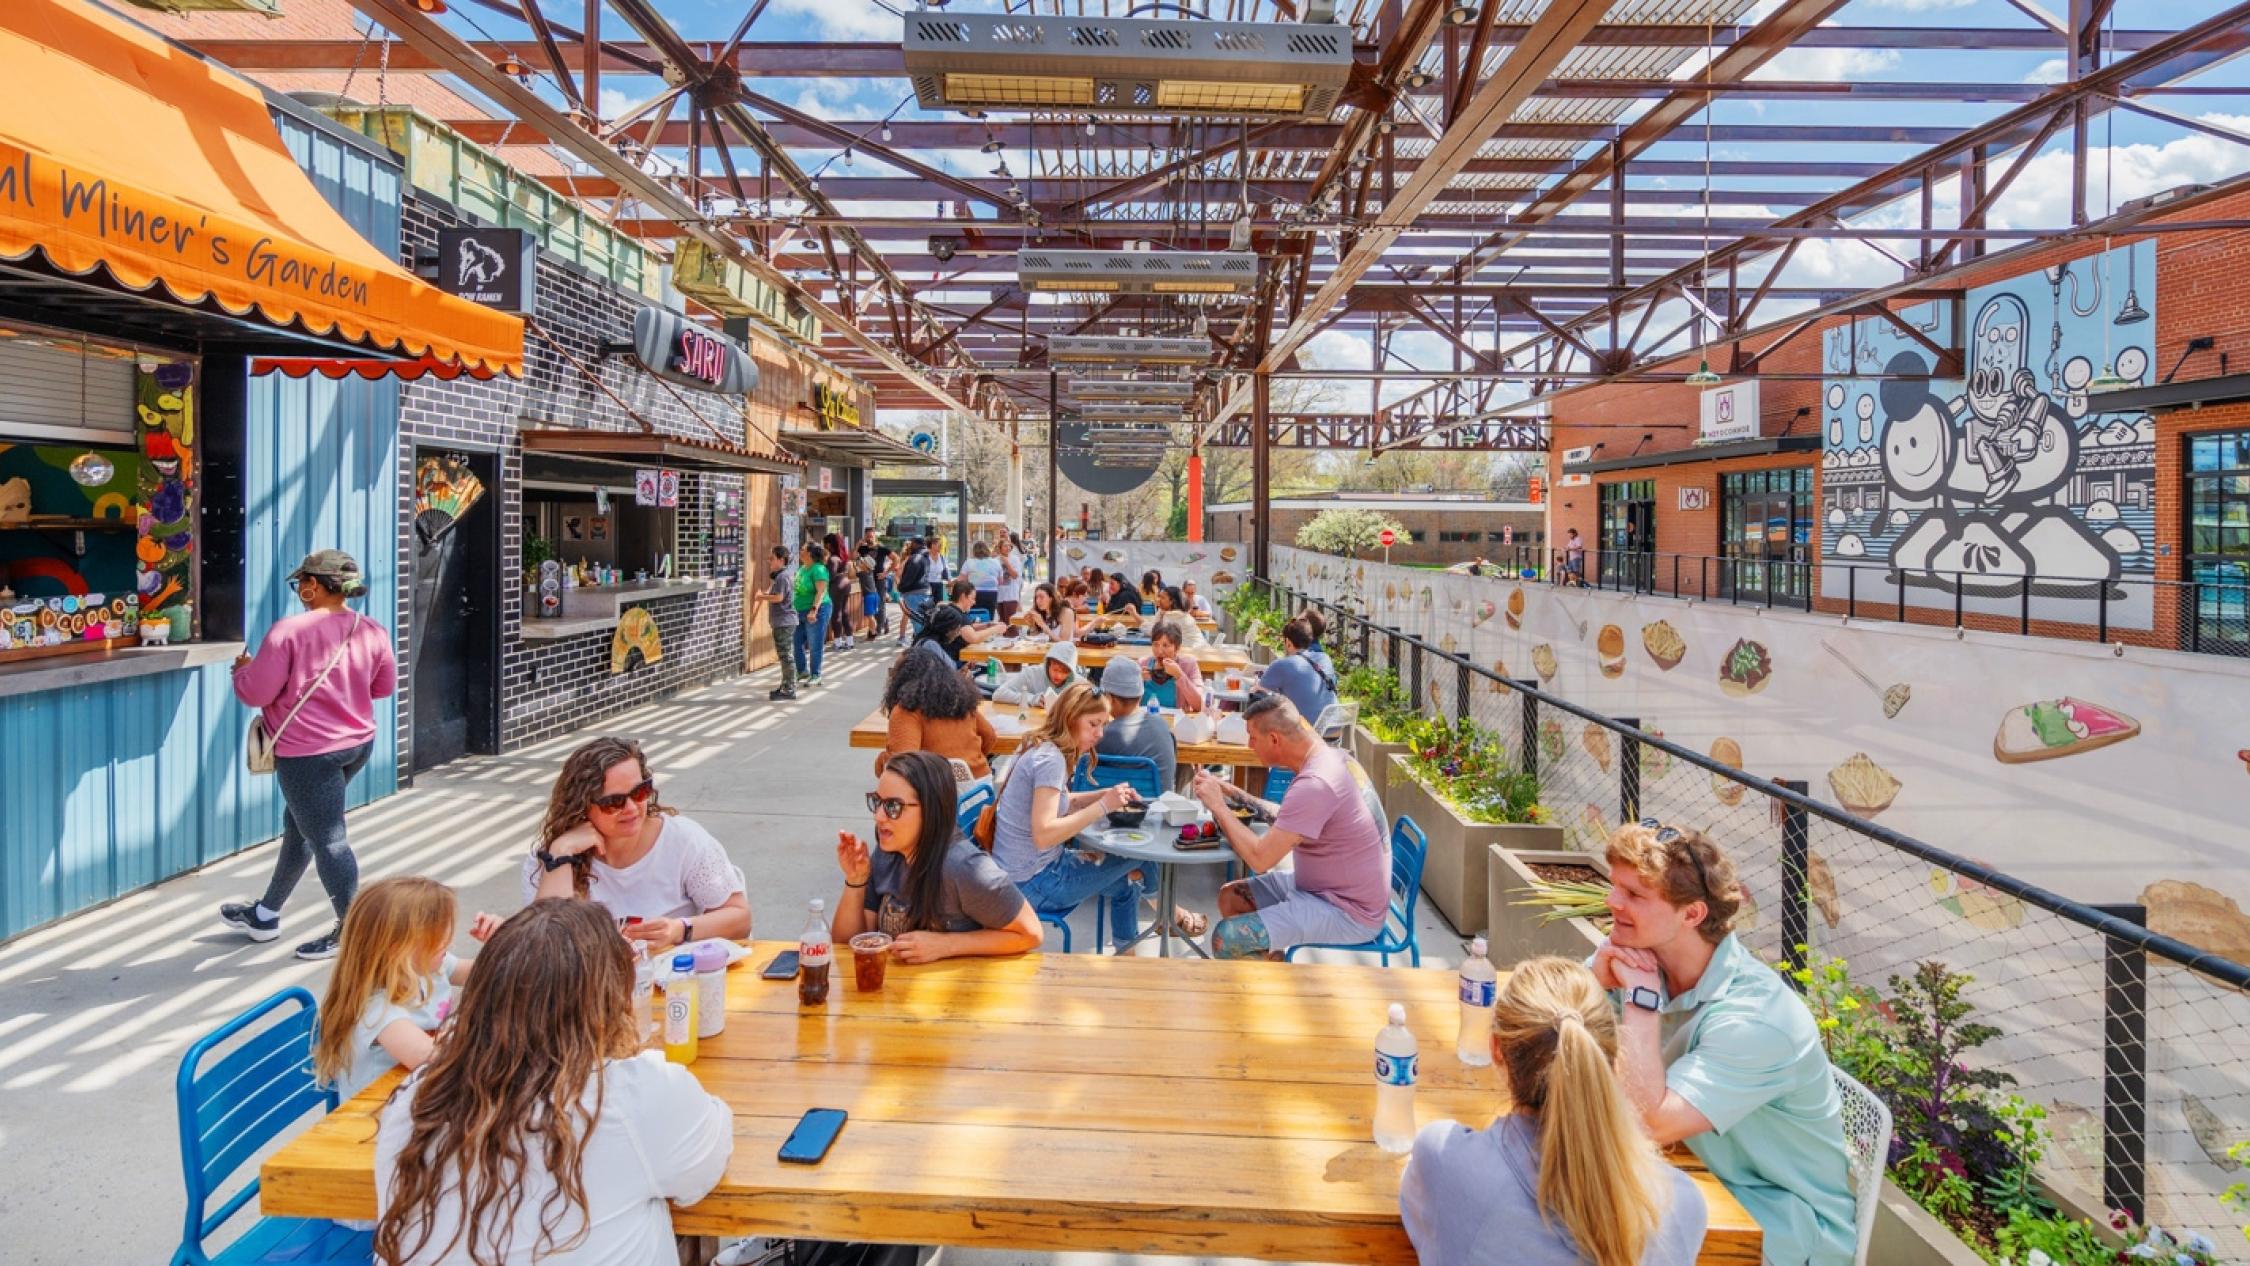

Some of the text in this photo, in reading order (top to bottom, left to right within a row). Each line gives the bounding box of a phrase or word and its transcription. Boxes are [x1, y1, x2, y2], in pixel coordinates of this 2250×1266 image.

[61, 168, 231, 265] Miner's
[246, 238, 367, 305] Garden
[680, 328, 727, 385] SARU
[672, 1005, 683, 1019] B
